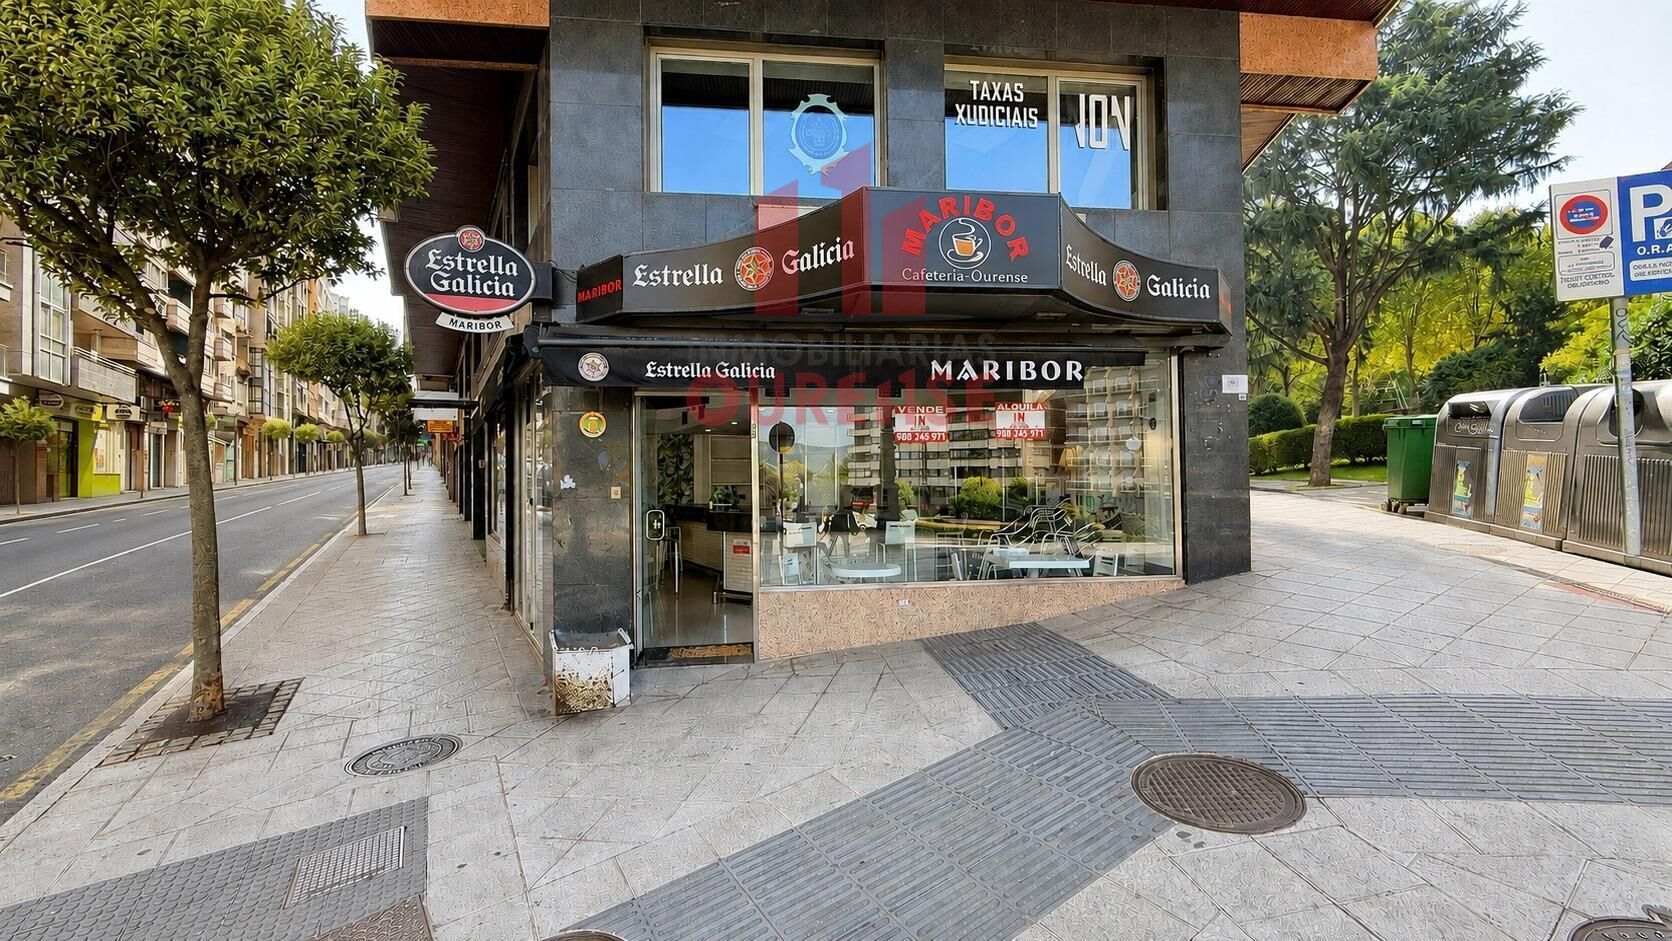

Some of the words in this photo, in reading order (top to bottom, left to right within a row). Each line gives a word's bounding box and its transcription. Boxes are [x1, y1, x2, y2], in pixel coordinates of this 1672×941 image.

[970, 79, 1024, 103] TAXAS
[955, 104, 1039, 128] XUDICIAIS
[901, 194, 1029, 262] MARIBOR
[425, 249, 518, 277] Estrella
[632, 264, 724, 288] Estrella
[781, 237, 855, 275] Galicia
[1066, 244, 1107, 286] Estrella
[1146, 274, 1211, 299] Galicia
[430, 270, 516, 298] Galicia
[902, 268, 1028, 283] Cafeteria-Ourense
[577, 279, 622, 303] MARIBOR
[448, 317, 502, 331] MARIBOR
[645, 361, 712, 379] Estrella
[715, 360, 776, 380] Galicia
[931, 359, 1083, 382] MARIBOR
[898, 405, 944, 414] VENDE
